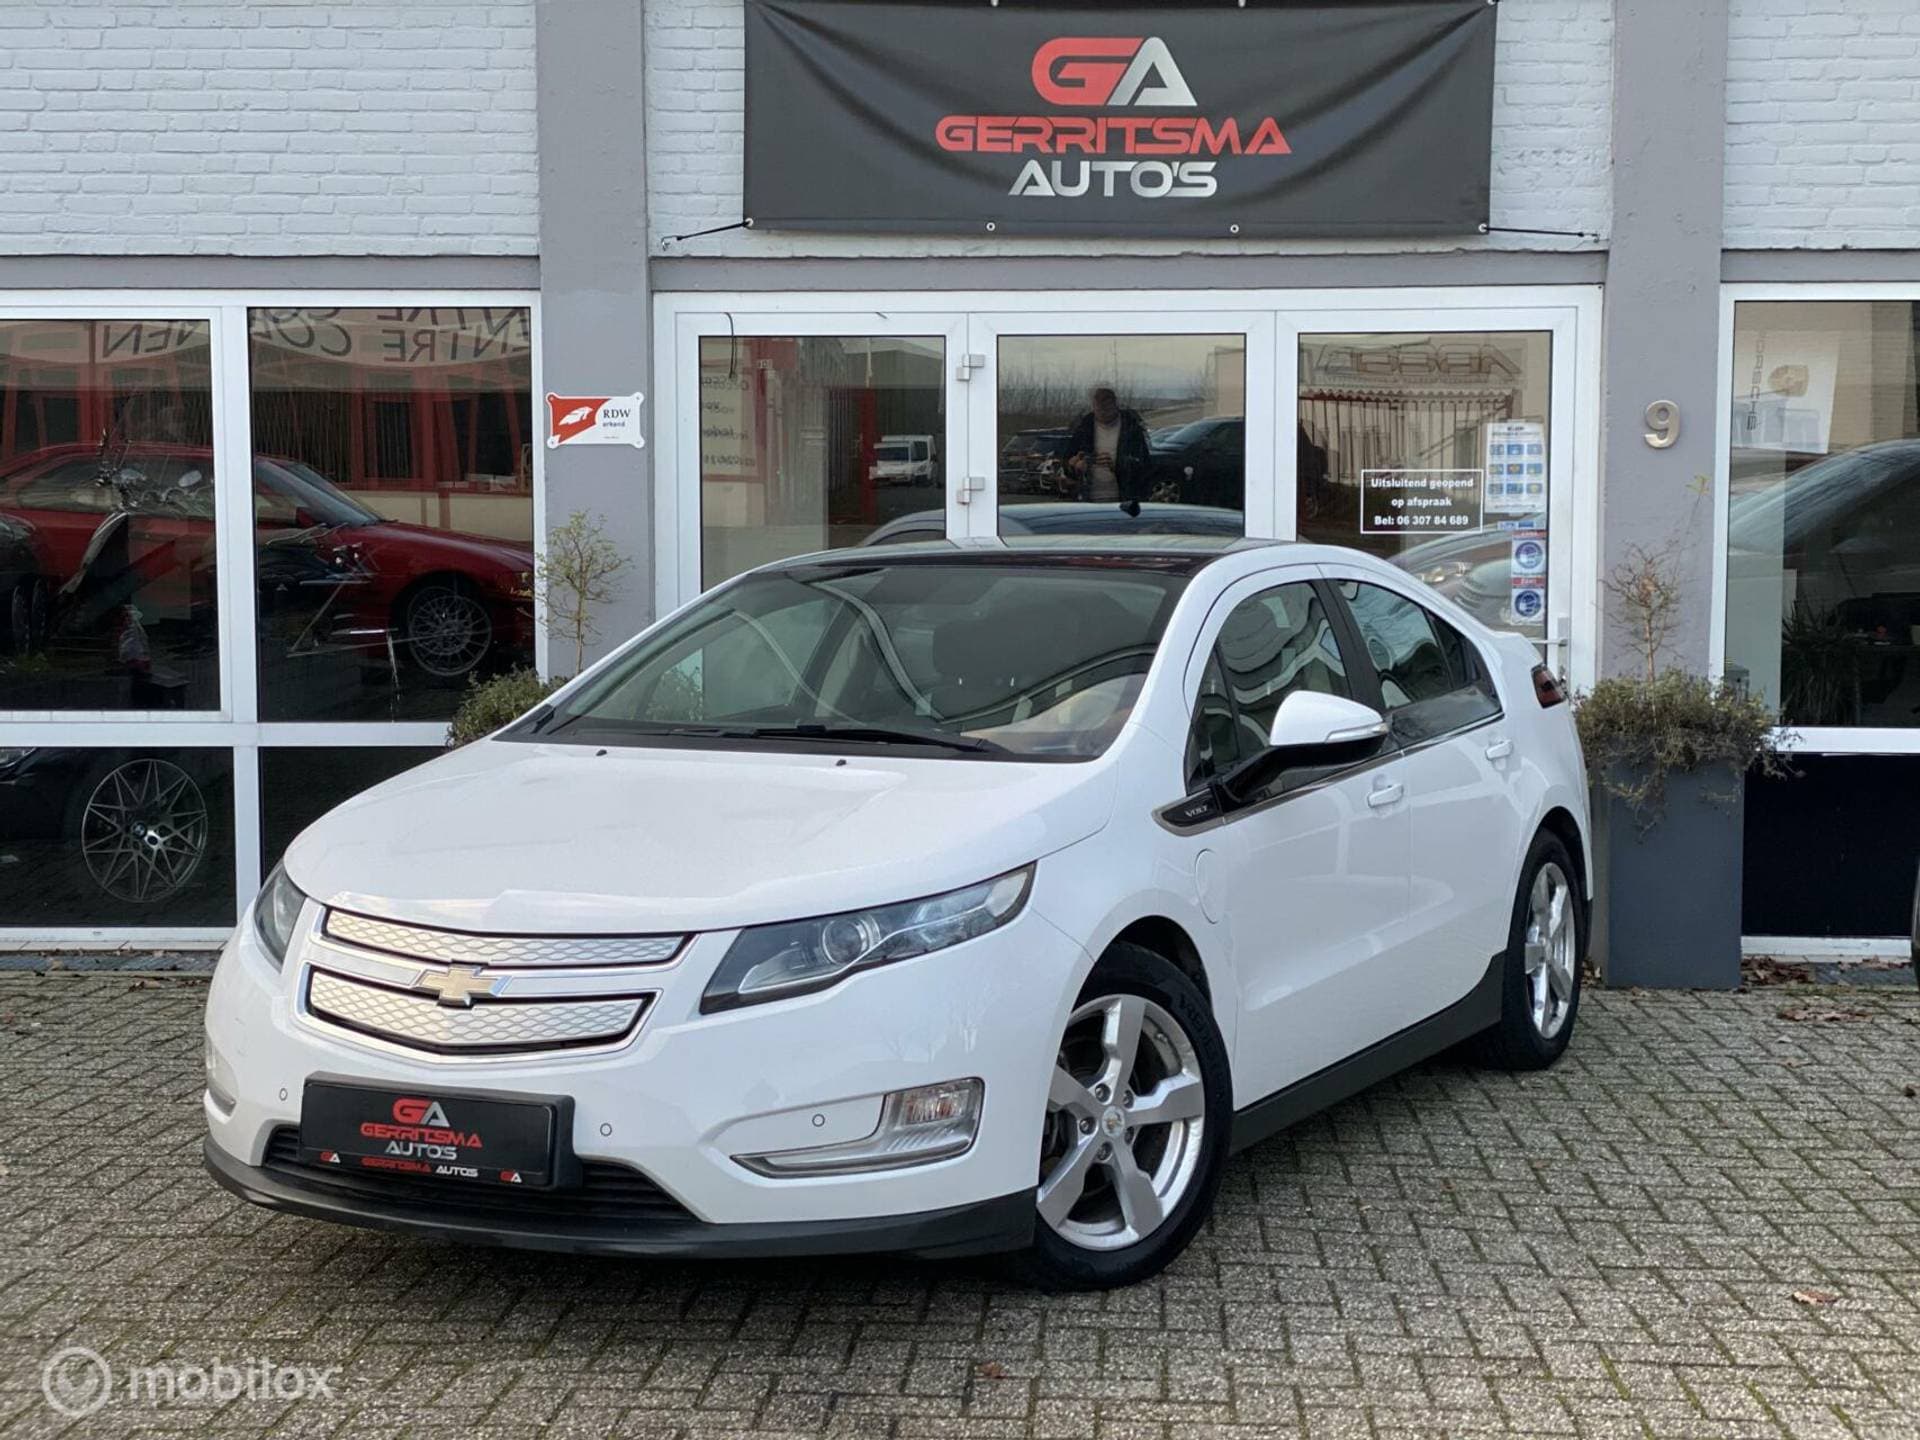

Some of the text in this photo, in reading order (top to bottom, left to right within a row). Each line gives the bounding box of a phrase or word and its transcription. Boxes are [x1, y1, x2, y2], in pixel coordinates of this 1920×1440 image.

[1031, 36, 1198, 107] GA
[935, 115, 1292, 155] GERRITSMA
[1008, 159, 1218, 198] AUTO'S
[603, 409, 630, 418] RDW
[1644, 399, 1680, 449] 9
[1371, 478, 1474, 490] Uitsluitend geopend
[1391, 497, 1452, 509] op afspraak
[1374, 516, 1395, 525] Bel:
[1396, 515, 1410, 525] 06
[1412, 515, 1431, 525] 307
[1449, 515, 1469, 525] 689
[393, 1097, 450, 1128] GA
[360, 1122, 482, 1147] GERRITSMA
